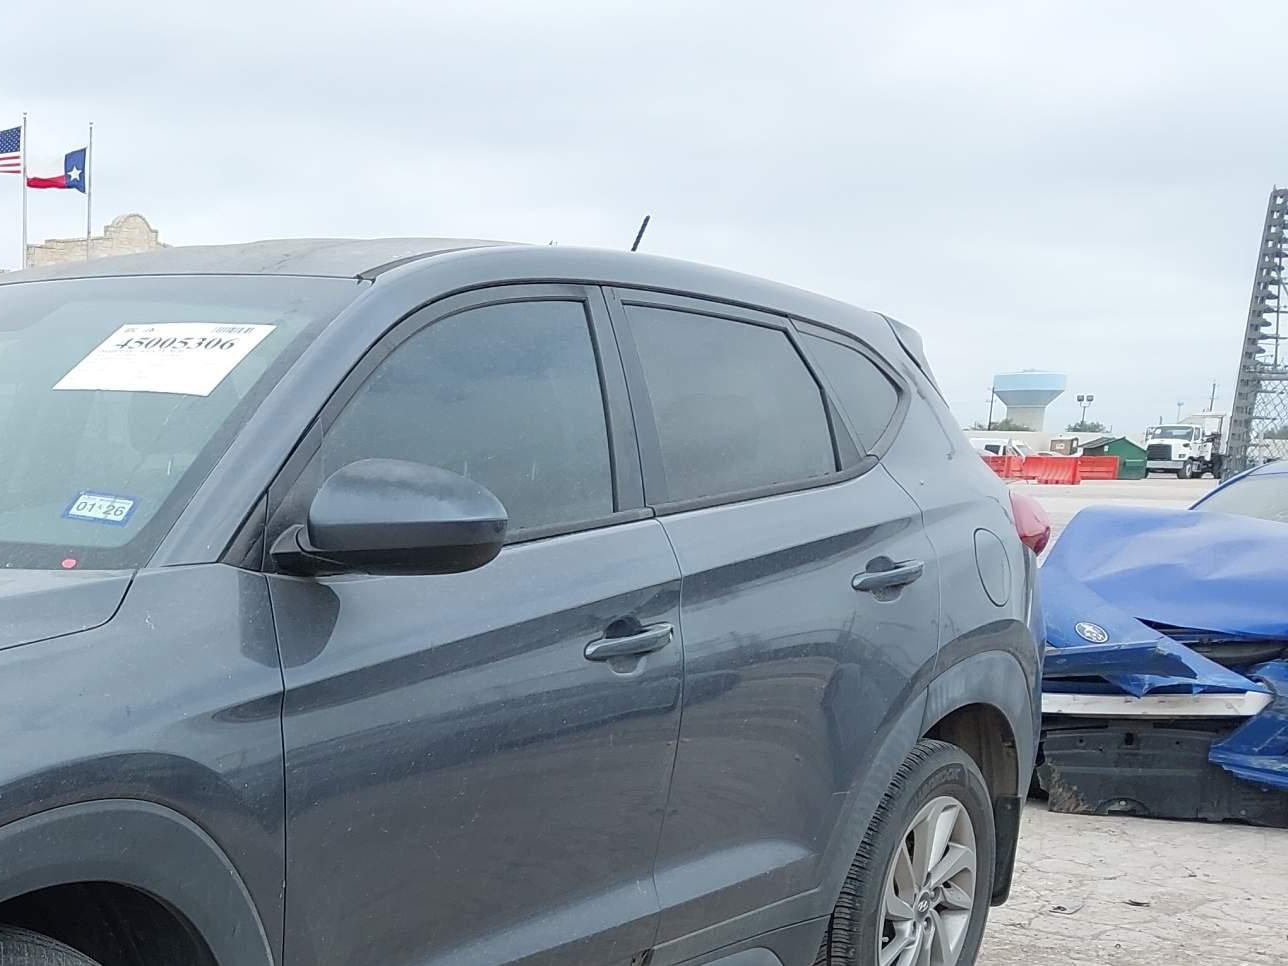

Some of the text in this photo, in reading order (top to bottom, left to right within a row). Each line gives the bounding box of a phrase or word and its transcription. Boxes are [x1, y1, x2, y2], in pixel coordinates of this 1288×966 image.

[115, 337, 238, 350] 45005306
[76, 501, 126, 517] 01 26
